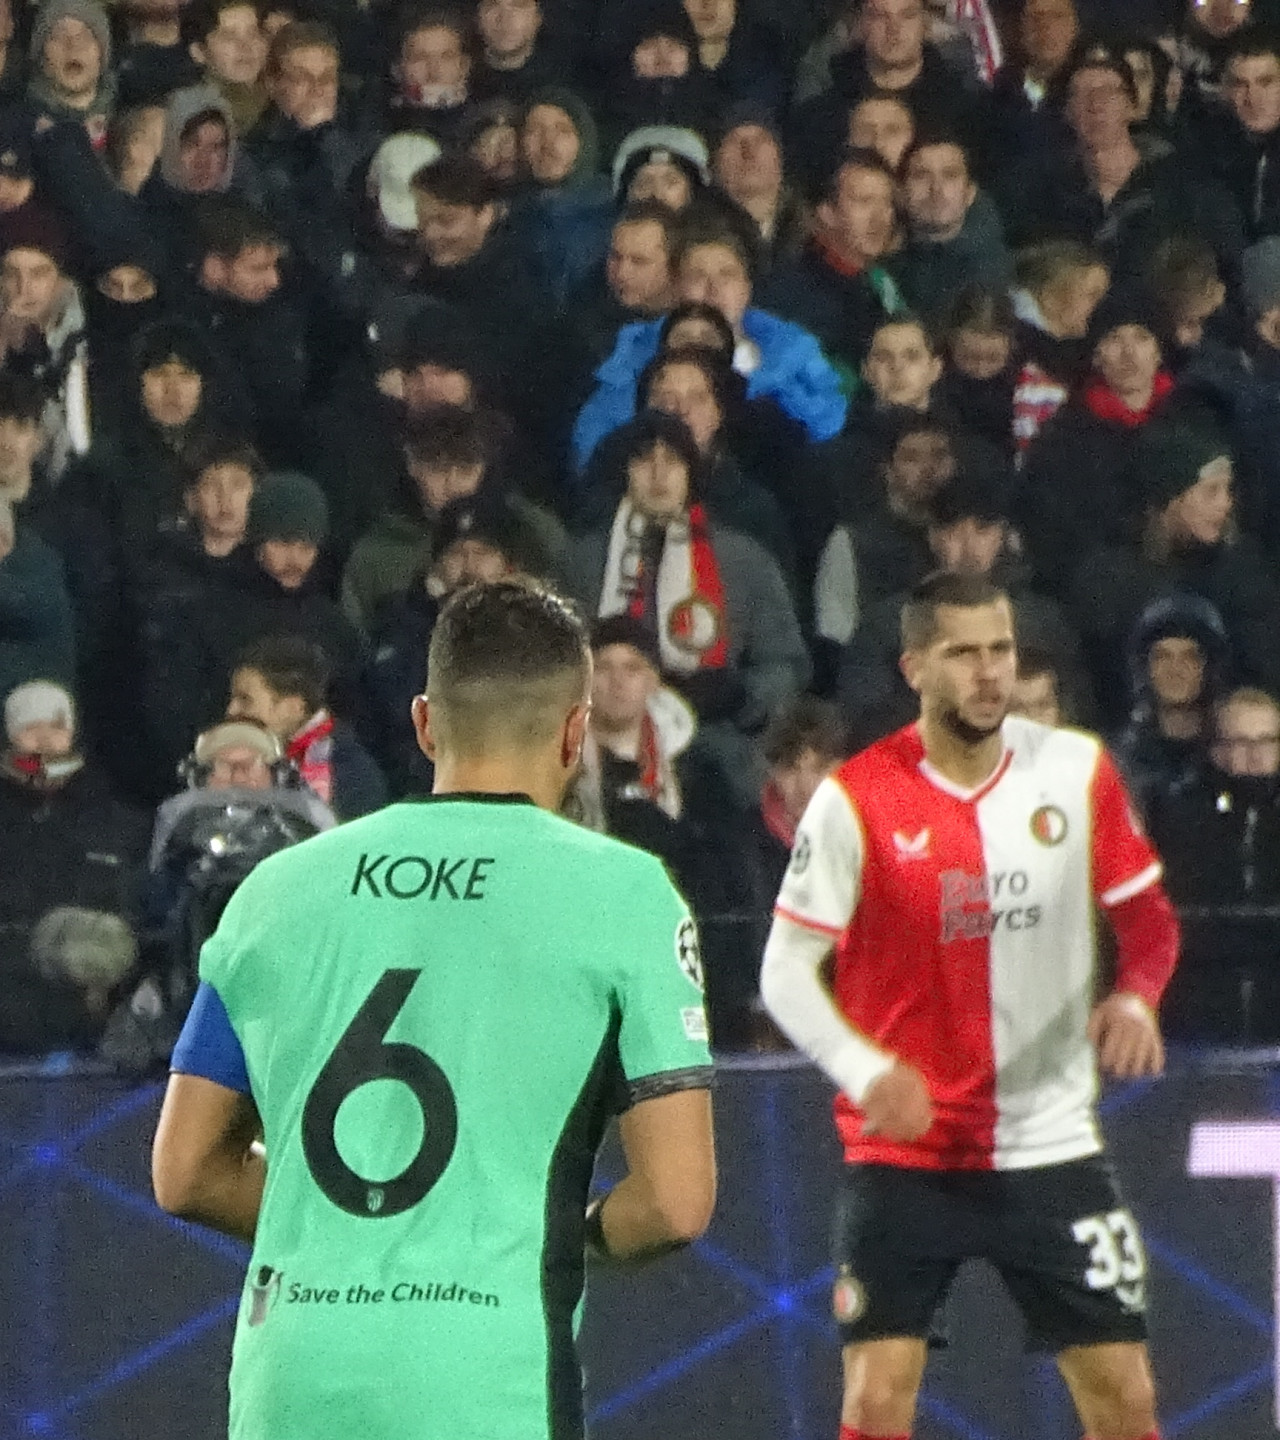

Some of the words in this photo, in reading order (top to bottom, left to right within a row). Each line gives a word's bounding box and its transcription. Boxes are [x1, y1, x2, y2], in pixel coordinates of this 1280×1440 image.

[350, 853, 496, 901] KOKE
[301, 968, 459, 1219] 6
[1071, 1210, 1145, 1290] 33
[286, 1282, 341, 1305] Save
[345, 1284, 386, 1305] the
[390, 1281, 500, 1308] Children
